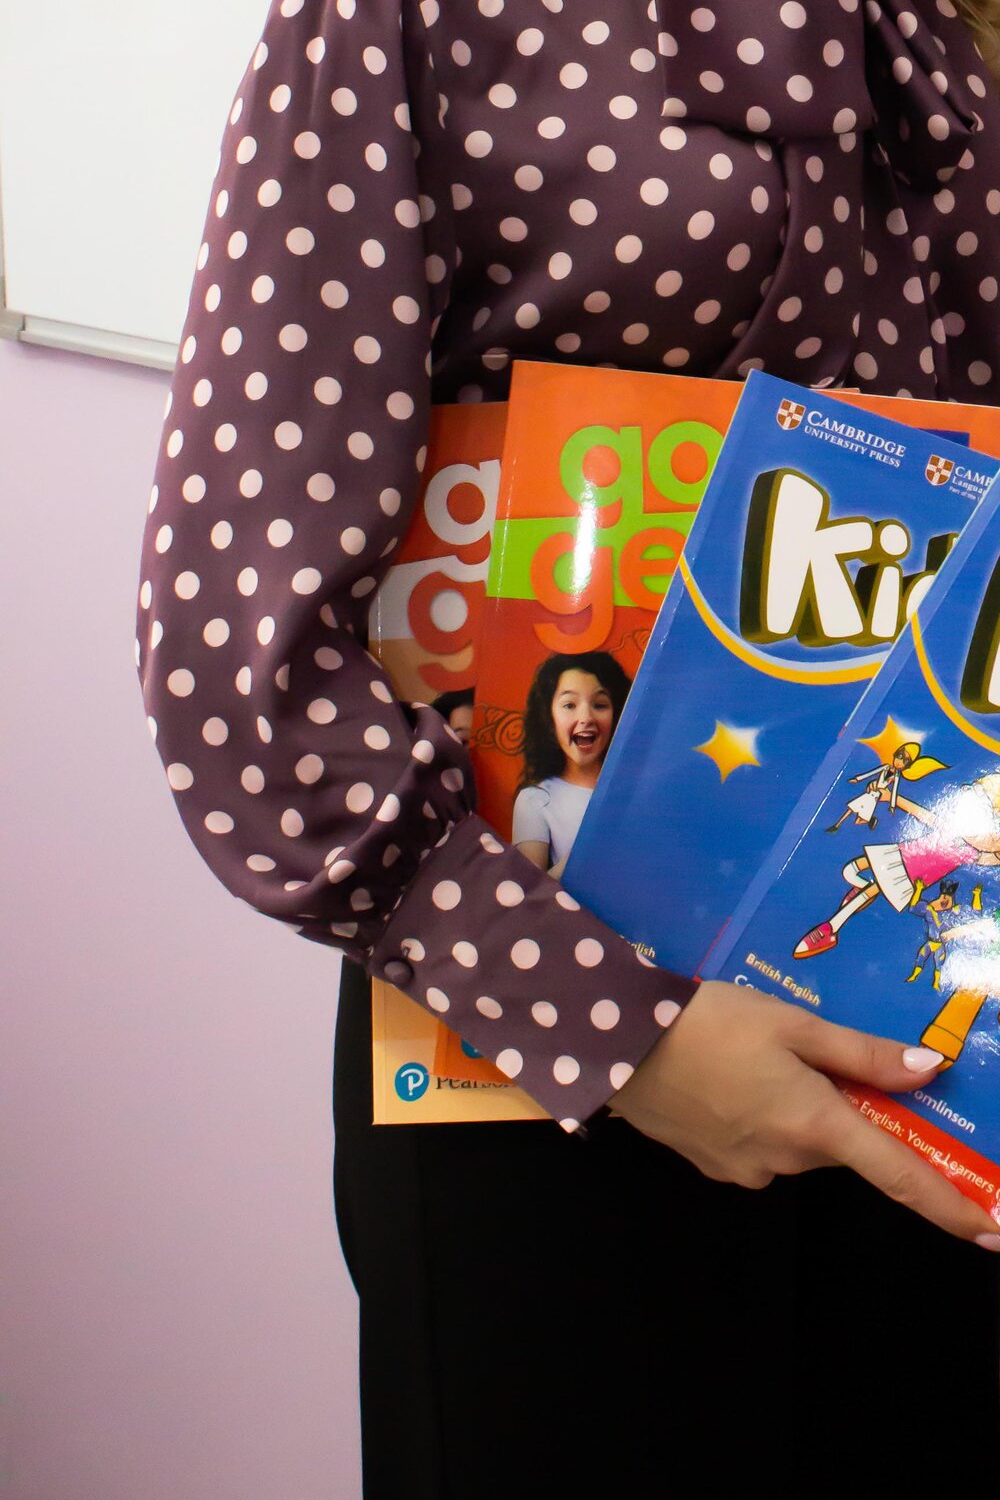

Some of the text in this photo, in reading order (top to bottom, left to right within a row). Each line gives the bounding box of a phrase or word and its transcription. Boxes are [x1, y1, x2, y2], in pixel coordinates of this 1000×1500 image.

[804, 425, 902, 469] UNIVERSITY PRESS
[806, 410, 906, 458] CAMBRIDGE
[745, 952, 782, 982] British
[781, 974, 821, 1007] English
[859, 1100, 906, 1138] English:
[907, 1087, 977, 1135] omlinson
